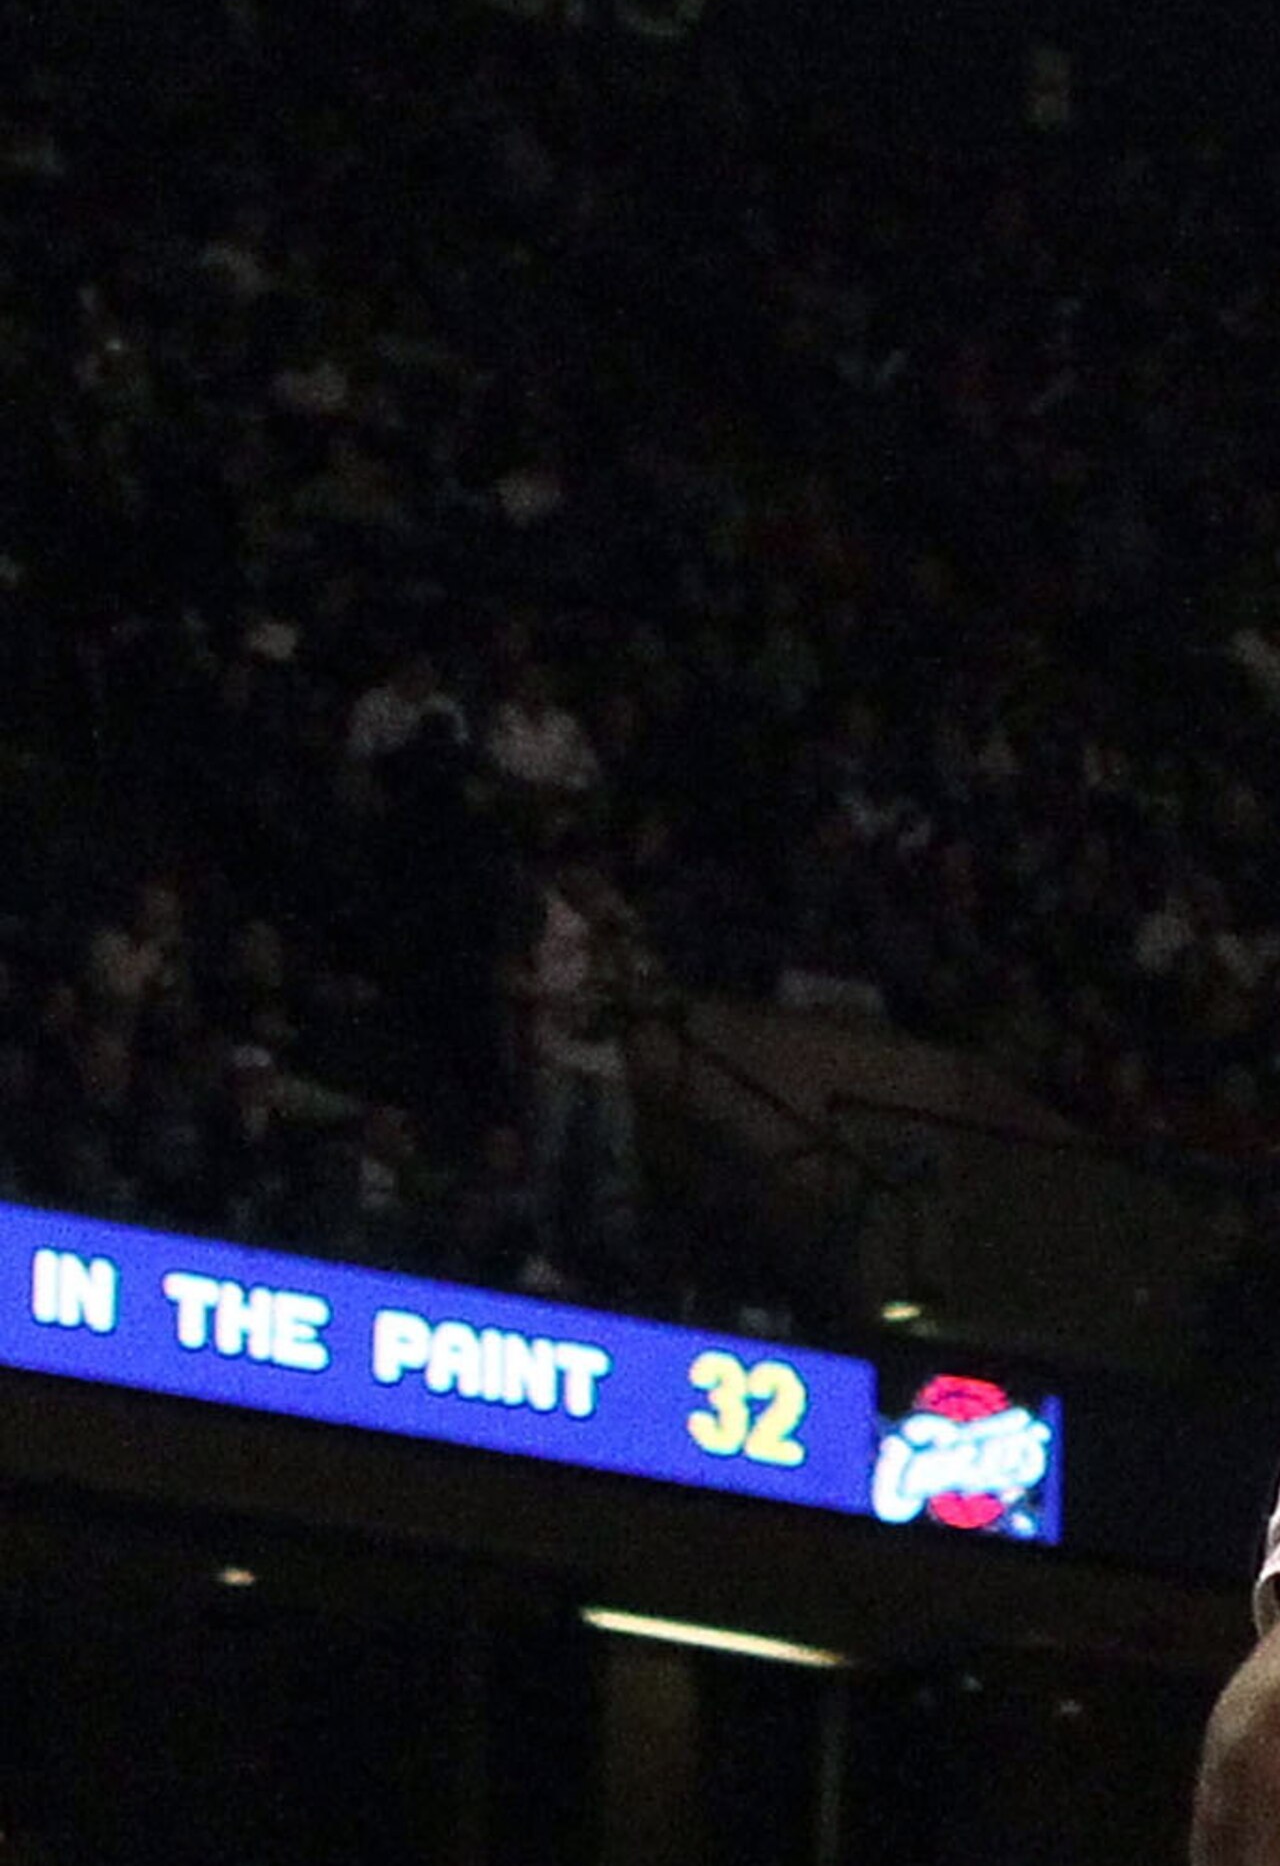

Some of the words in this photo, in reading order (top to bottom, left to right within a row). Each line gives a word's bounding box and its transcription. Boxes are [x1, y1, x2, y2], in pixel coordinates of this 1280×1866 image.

[32, 1247, 118, 1334] IN
[163, 1271, 331, 1372] THE
[372, 1309, 612, 1419] PAINT
[688, 1350, 806, 1468] 32
